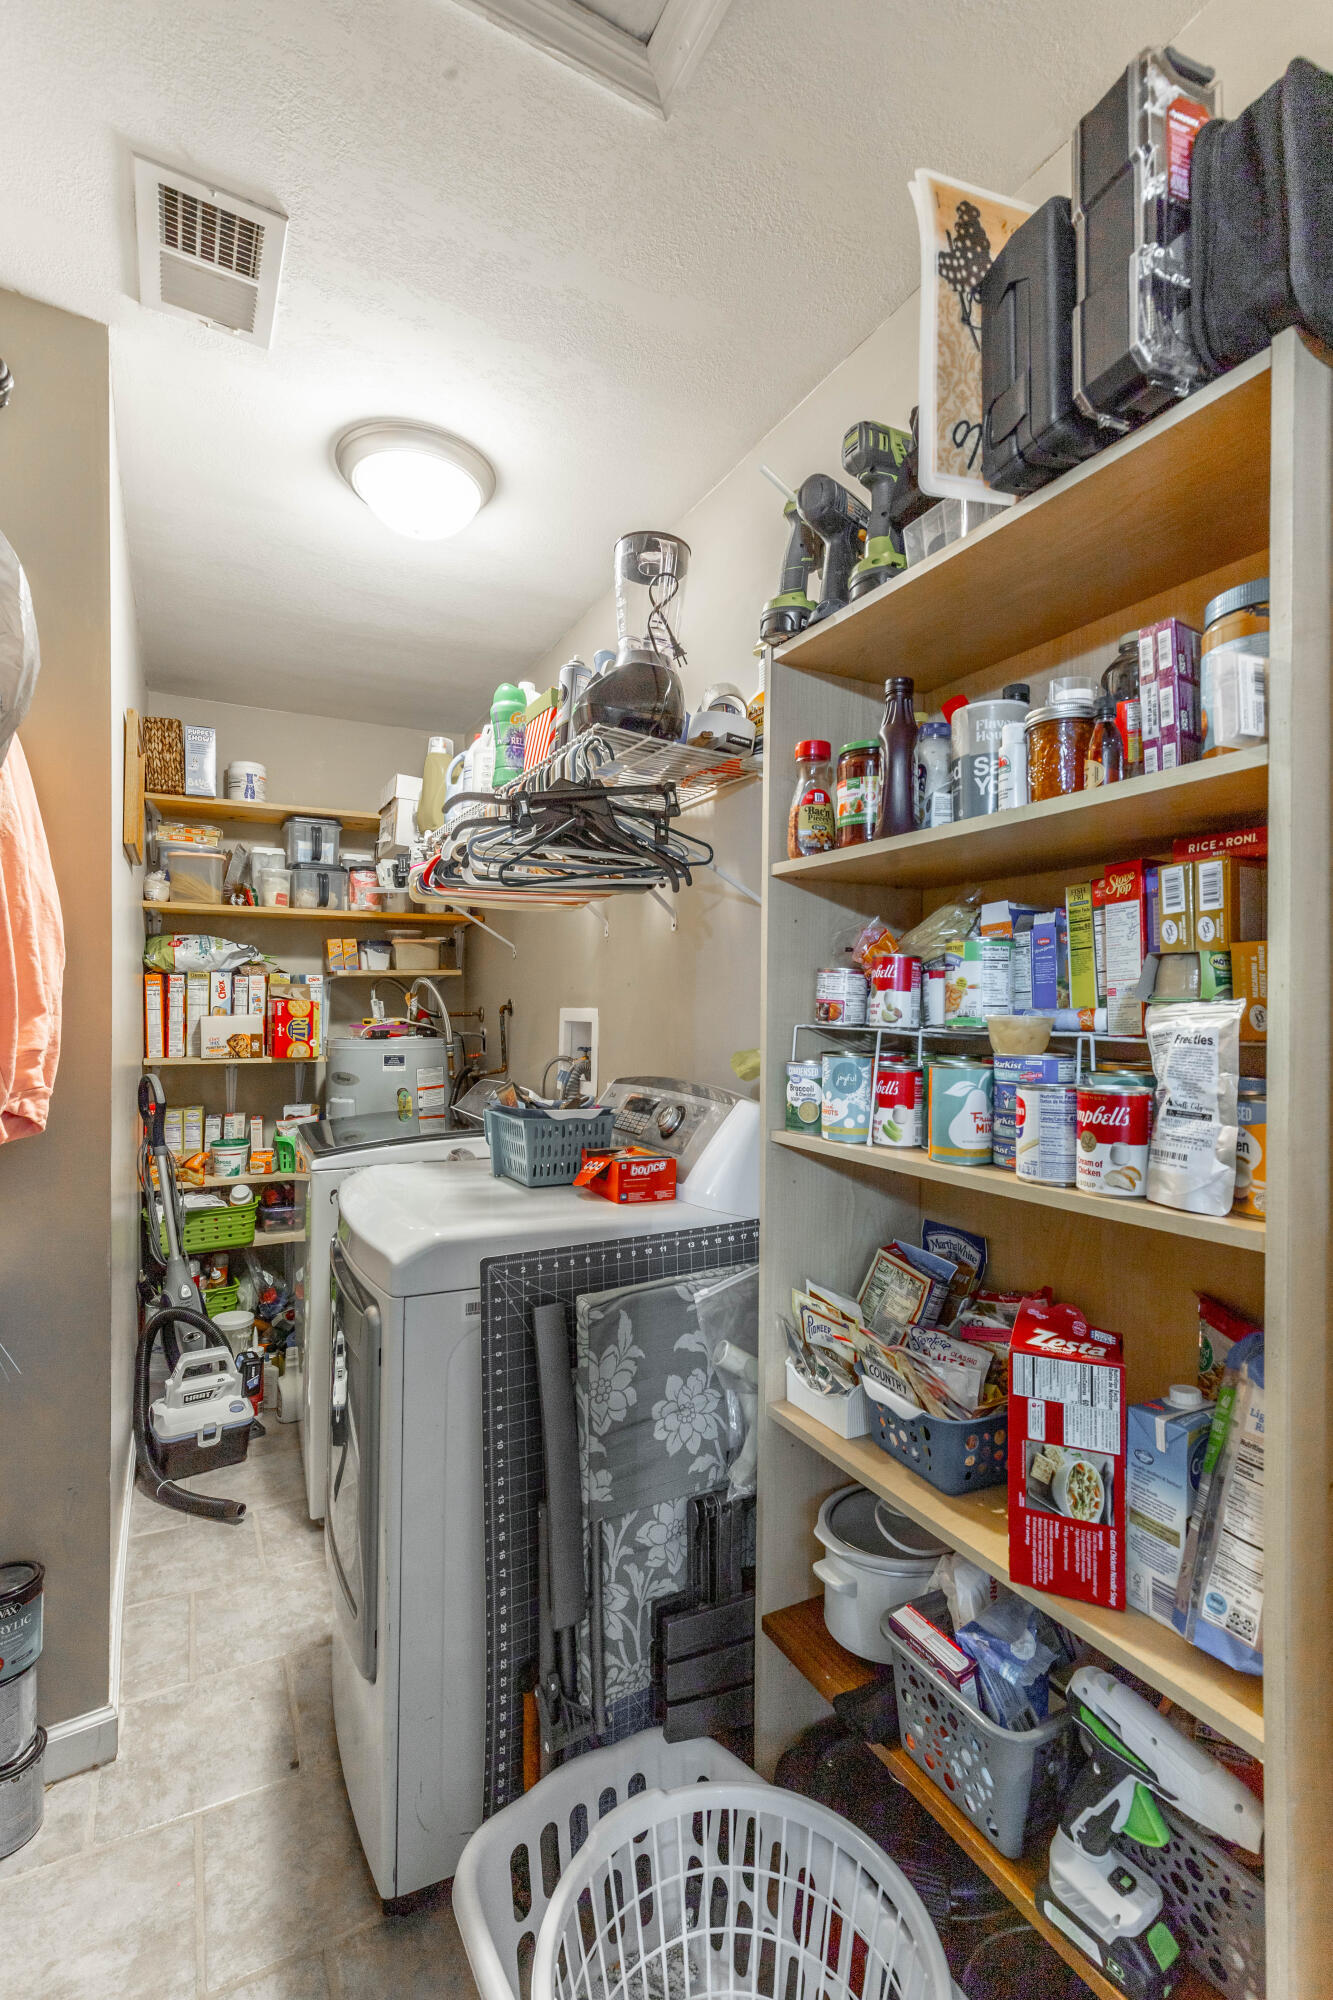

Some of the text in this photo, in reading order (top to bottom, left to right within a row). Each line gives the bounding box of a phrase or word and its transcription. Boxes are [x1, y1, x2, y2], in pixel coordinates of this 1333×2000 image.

[1188, 840, 1217, 854] RICE
[1226, 832, 1257, 847] RONI
[1106, 872, 1136, 894] Stove
[1114, 883, 1132, 898] Top
[218, 980, 226, 1000] Chex
[293, 1018, 309, 1041] RITZ
[994, 1060, 1021, 1069] StarKist
[836, 1074, 856, 1086] joyful
[790, 1084, 814, 1092] Broccoli
[976, 1124, 992, 1134] MIX
[632, 1160, 666, 1176] bounce
[1095, 1160, 1103, 1168] of
[957, 1241, 978, 1264] White
[521, 1266, 526, 1274] 2
[807, 1315, 832, 1340] PIONEER
[1026, 1328, 1107, 1356] Zesta
[868, 1364, 908, 1394] COUNTRY
[497, 1440, 504, 1450] 10
[498, 1458, 504, 1468] 11
[498, 1476, 504, 1487] 12
[498, 1494, 504, 1504] 13
[499, 1512, 505, 1523] 14
[499, 1532, 506, 1542] 15
[500, 1550, 506, 1560] 16
[1110, 1550, 1118, 1571] Chicken
[500, 1568, 506, 1578] 17
[1110, 1572, 1118, 1591] Noodle
[500, 1586, 506, 1596] 18
[1108, 1591, 1118, 1606] Soup
[500, 1605, 506, 1615] 19
[500, 1622, 506, 1634] 20
[500, 1642, 506, 1652] 21
[500, 1659, 506, 1670] 22
[500, 1676, 506, 1688] 23
[500, 1694, 506, 1705] 24
[500, 1712, 506, 1722] 25
[500, 1729, 506, 1739] 26
[500, 1746, 506, 1754] 27
